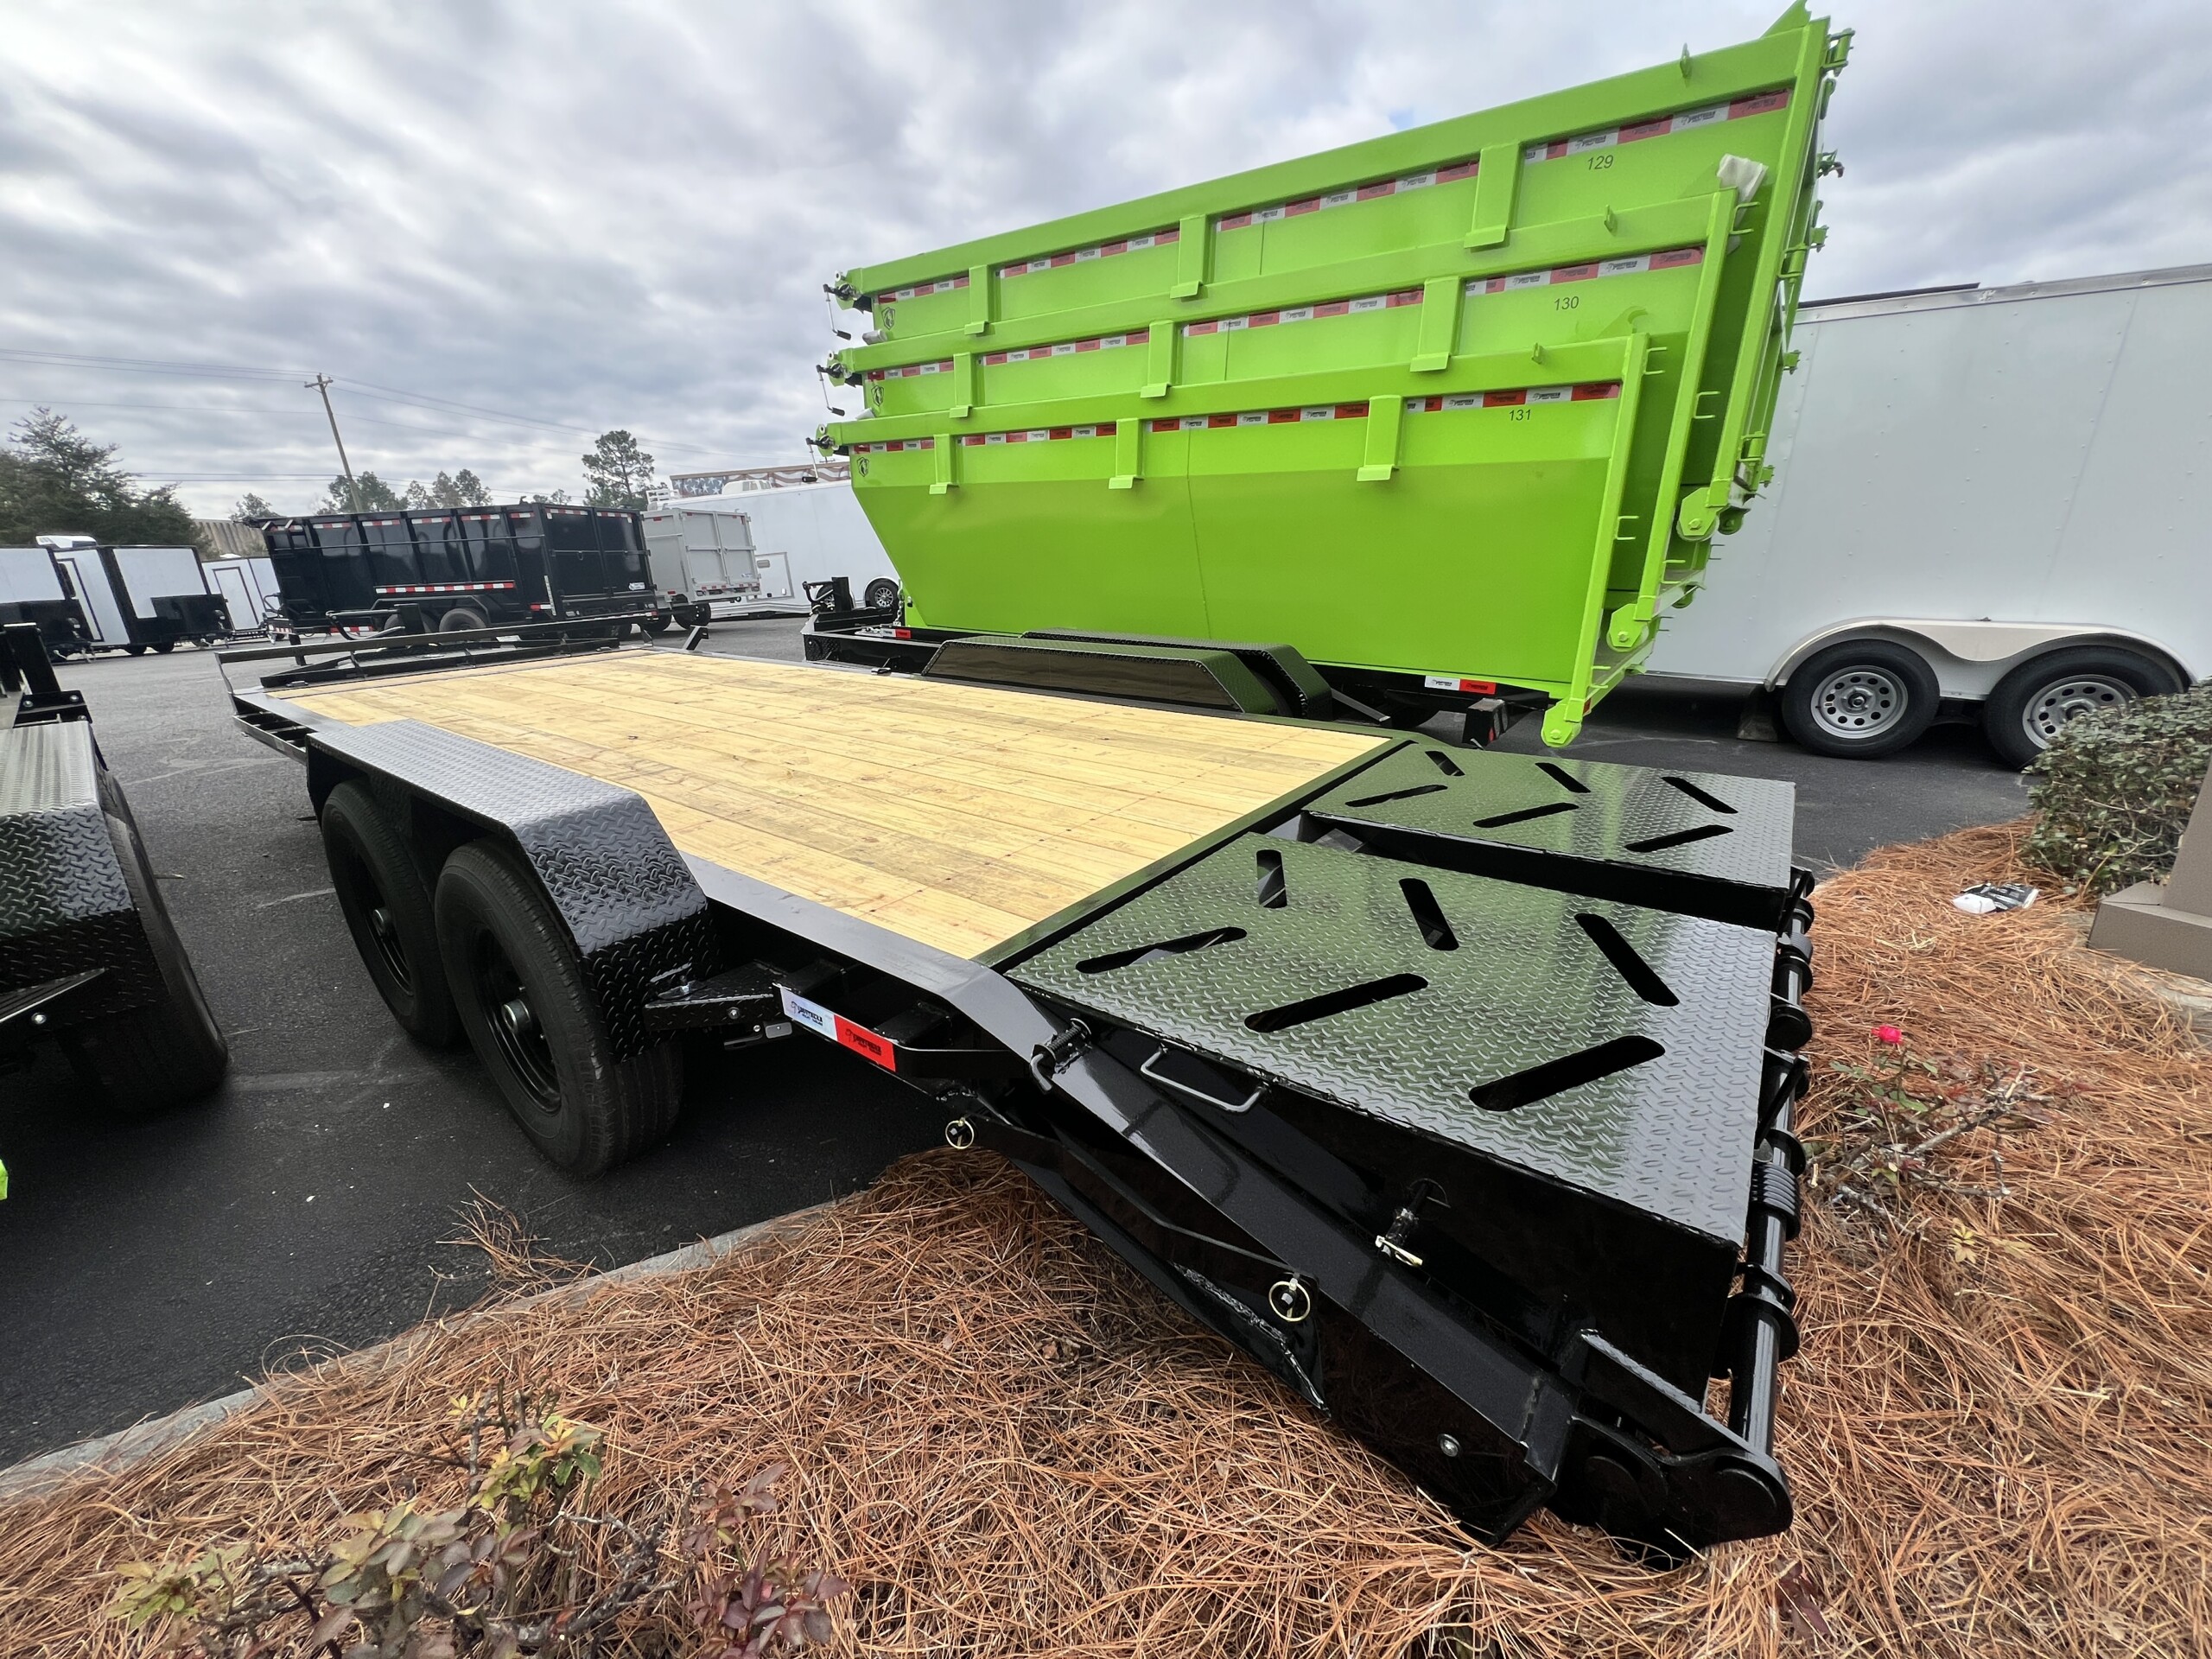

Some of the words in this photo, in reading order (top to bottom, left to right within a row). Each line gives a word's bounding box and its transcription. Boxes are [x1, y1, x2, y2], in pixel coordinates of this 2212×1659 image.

[1587, 155, 1614, 170] 129
[1554, 296, 1580, 311] 130
[1509, 409, 1531, 421] 131
